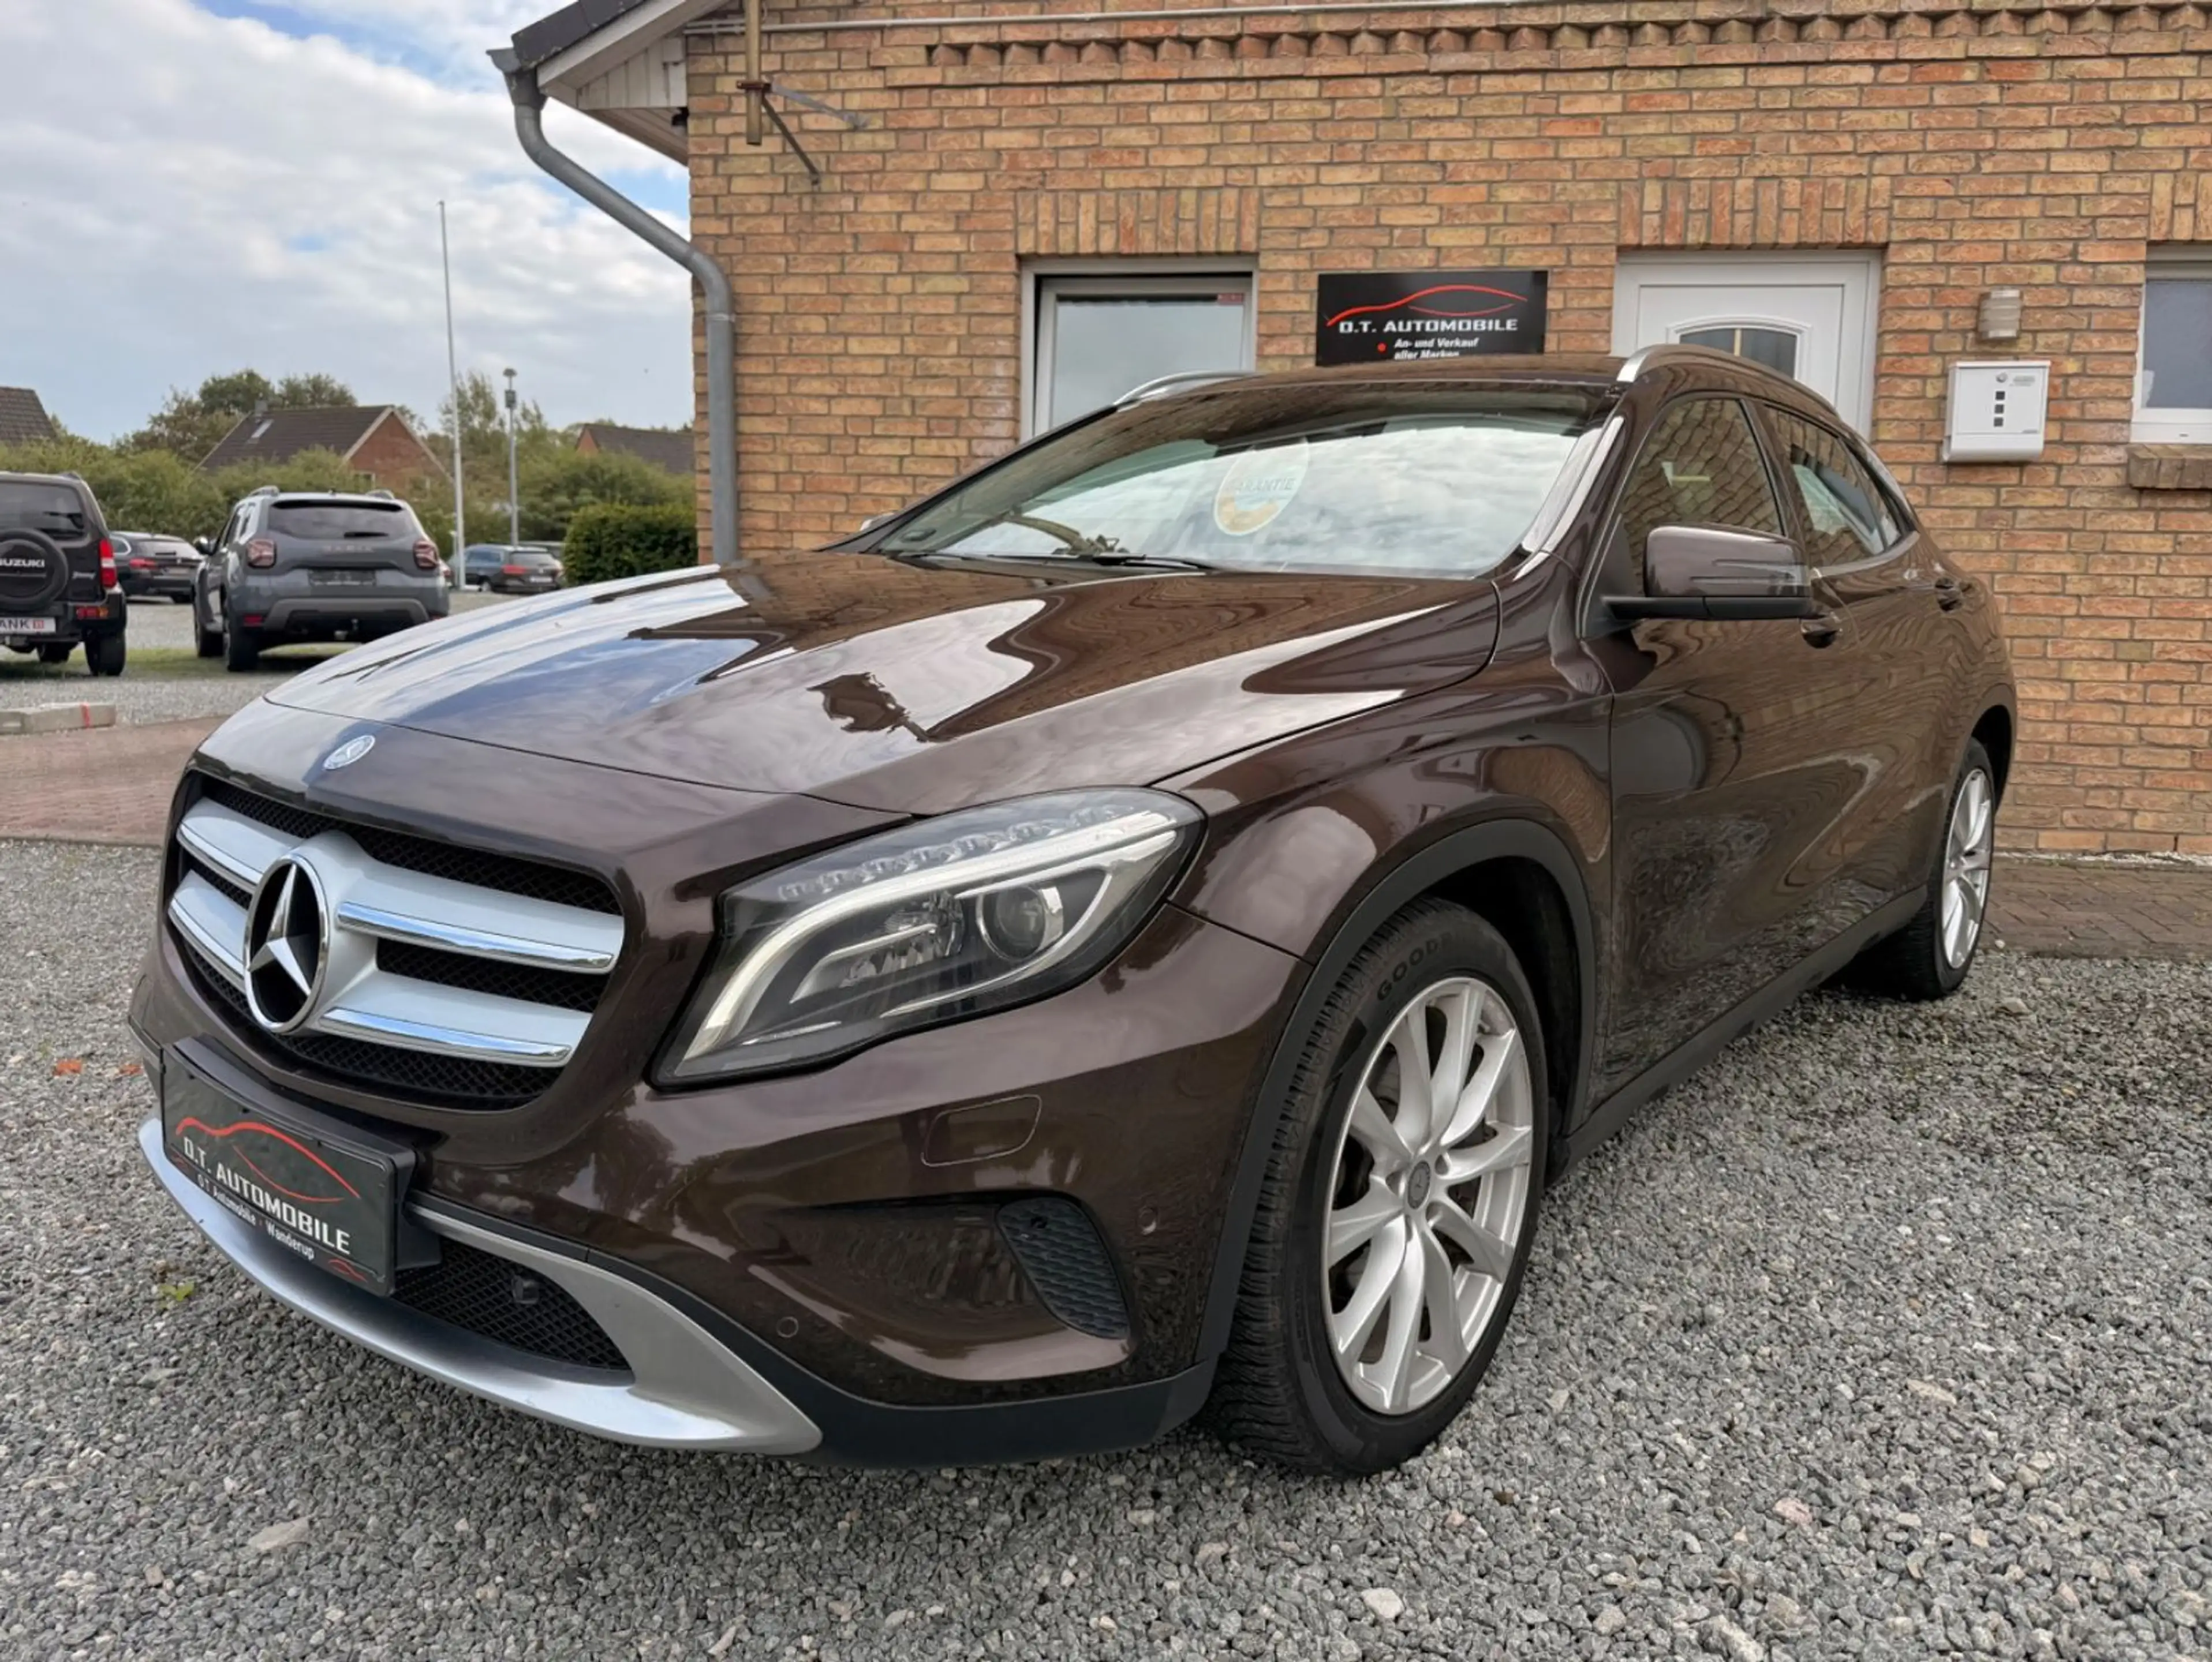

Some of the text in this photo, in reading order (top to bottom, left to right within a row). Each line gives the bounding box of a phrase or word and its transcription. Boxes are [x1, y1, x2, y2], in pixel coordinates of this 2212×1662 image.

[1339, 318, 1518, 333] O.T. AUTOMOBILE
[1394, 337, 1479, 348] An- und Verkauf
[1394, 349, 1460, 360] aller Marken
[184, 1136, 351, 1255] O.T. AUTOMOBILE
[265, 1219, 315, 1261] Wanderup
